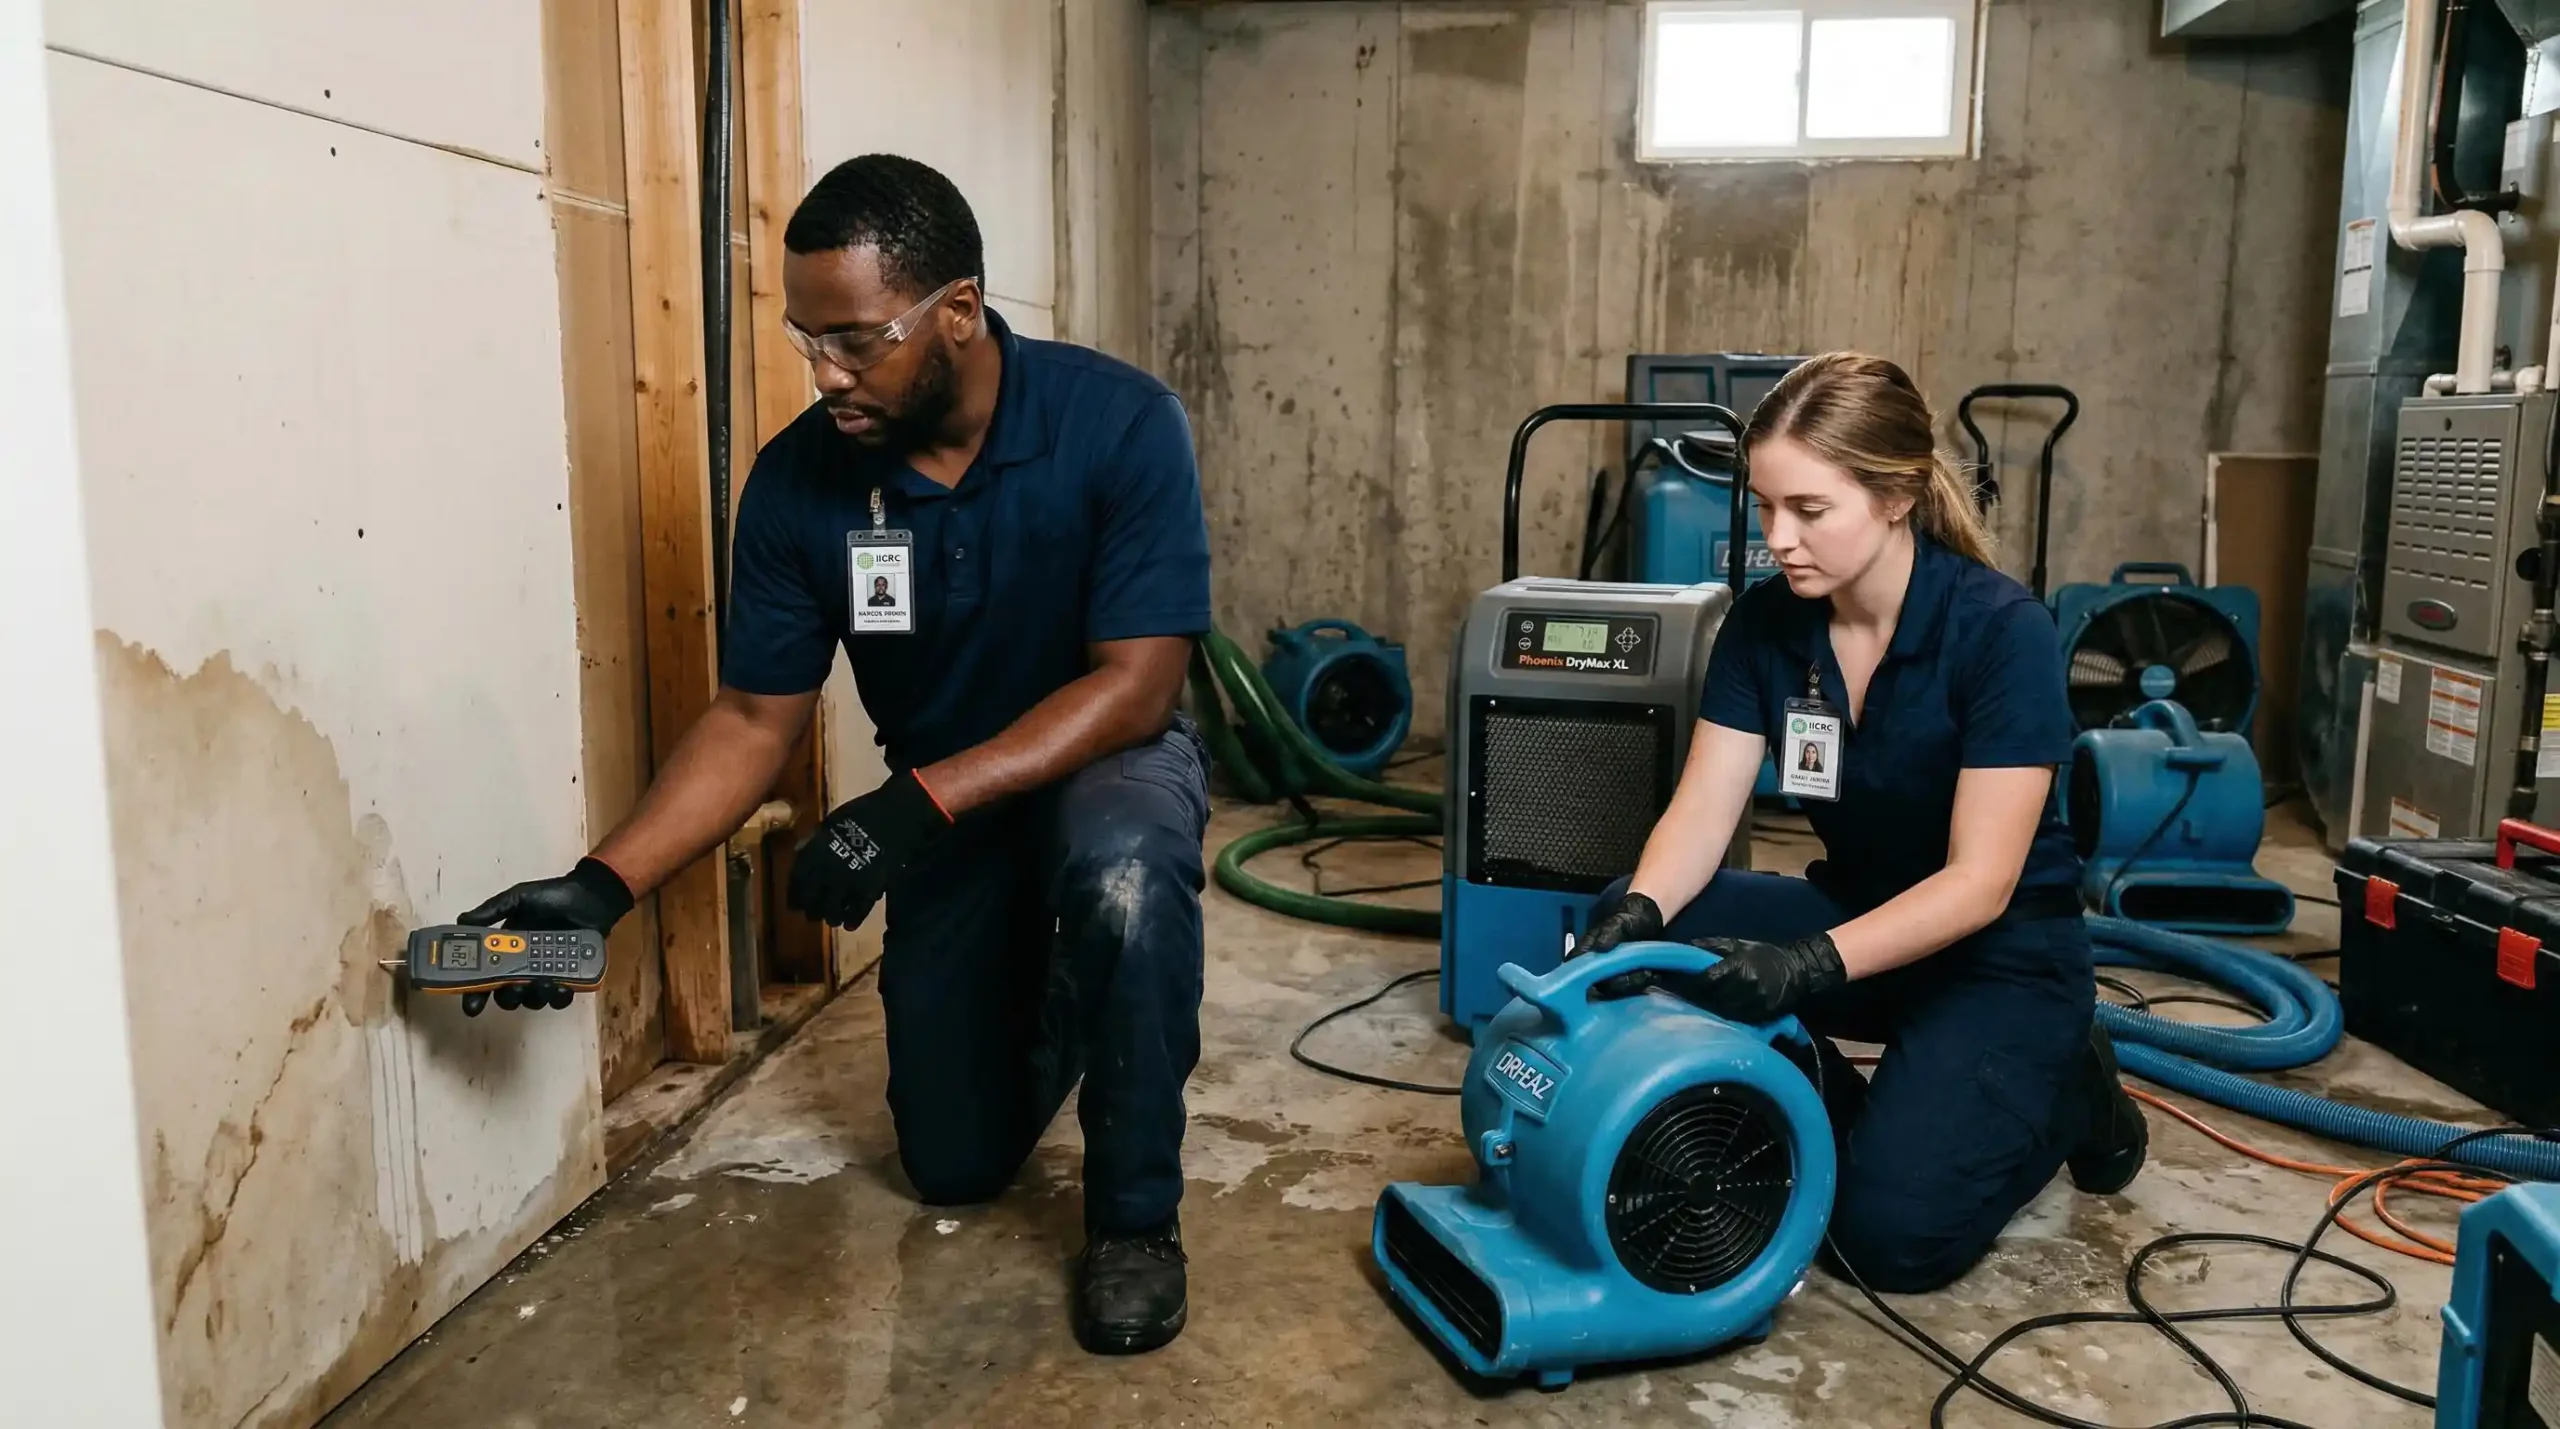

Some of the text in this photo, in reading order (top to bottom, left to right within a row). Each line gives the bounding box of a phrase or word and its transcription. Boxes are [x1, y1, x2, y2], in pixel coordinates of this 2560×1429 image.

[876, 554, 901, 562] IICRC
[1519, 654, 1629, 670] Phoenix DryMax XL
[1809, 722, 1833, 731] IICRC
[1496, 1051, 1555, 1100] DRI-EAZ
